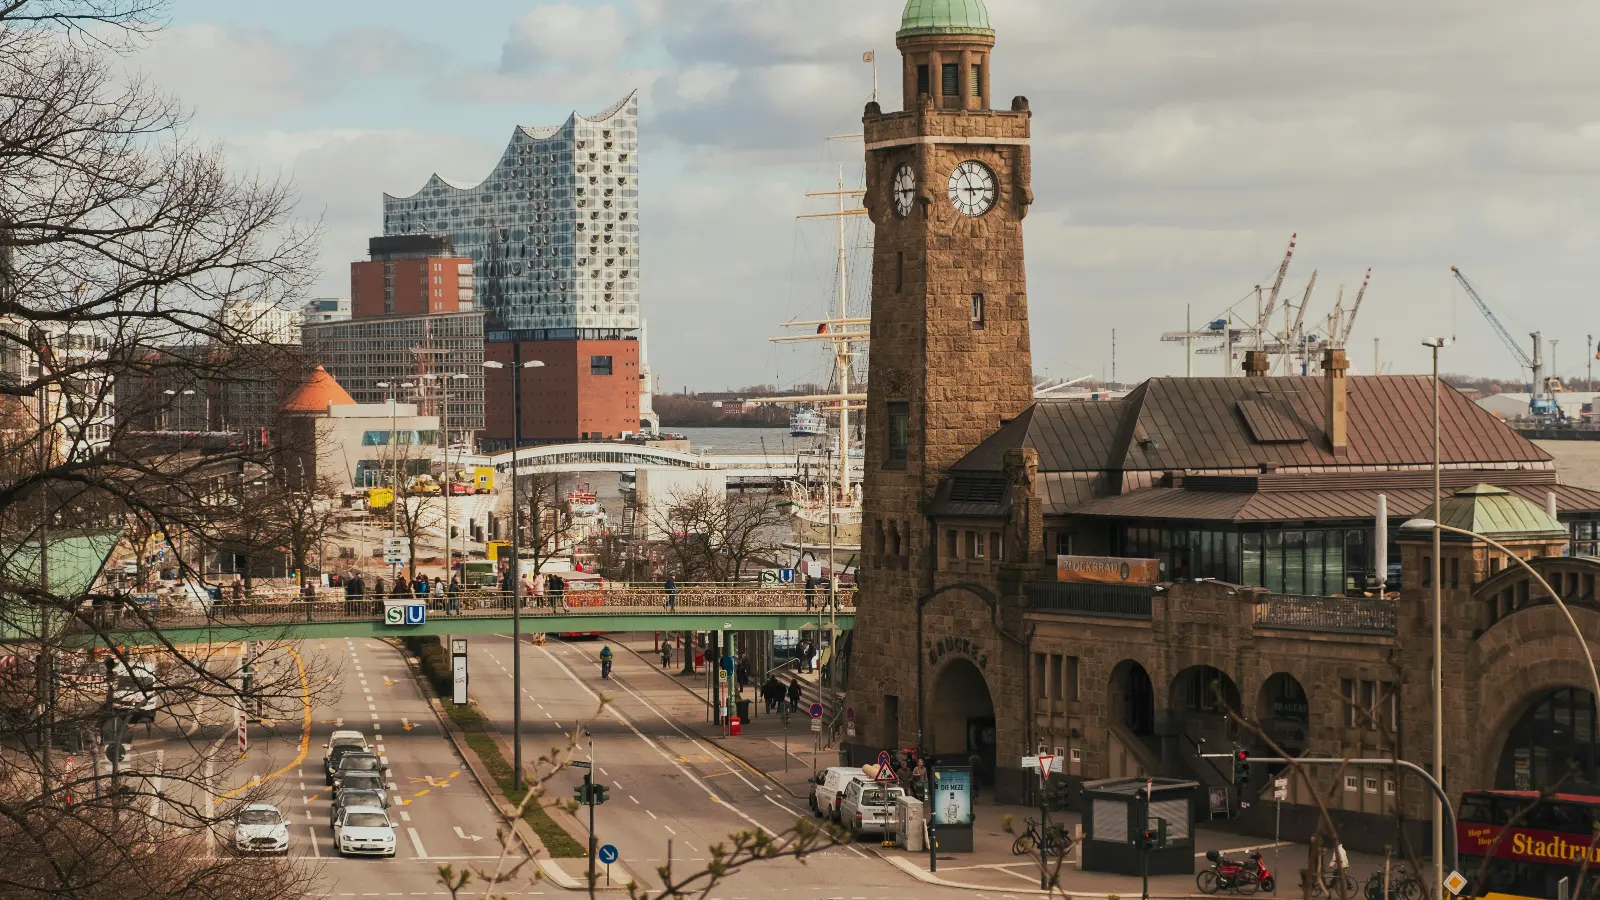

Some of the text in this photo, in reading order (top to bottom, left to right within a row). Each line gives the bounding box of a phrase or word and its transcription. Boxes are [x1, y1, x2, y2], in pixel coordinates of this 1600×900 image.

[780, 569, 793, 583] U
[387, 606, 423, 622] S U
[1468, 829, 1482, 838] Hop
[1478, 838, 1492, 846] Hop
